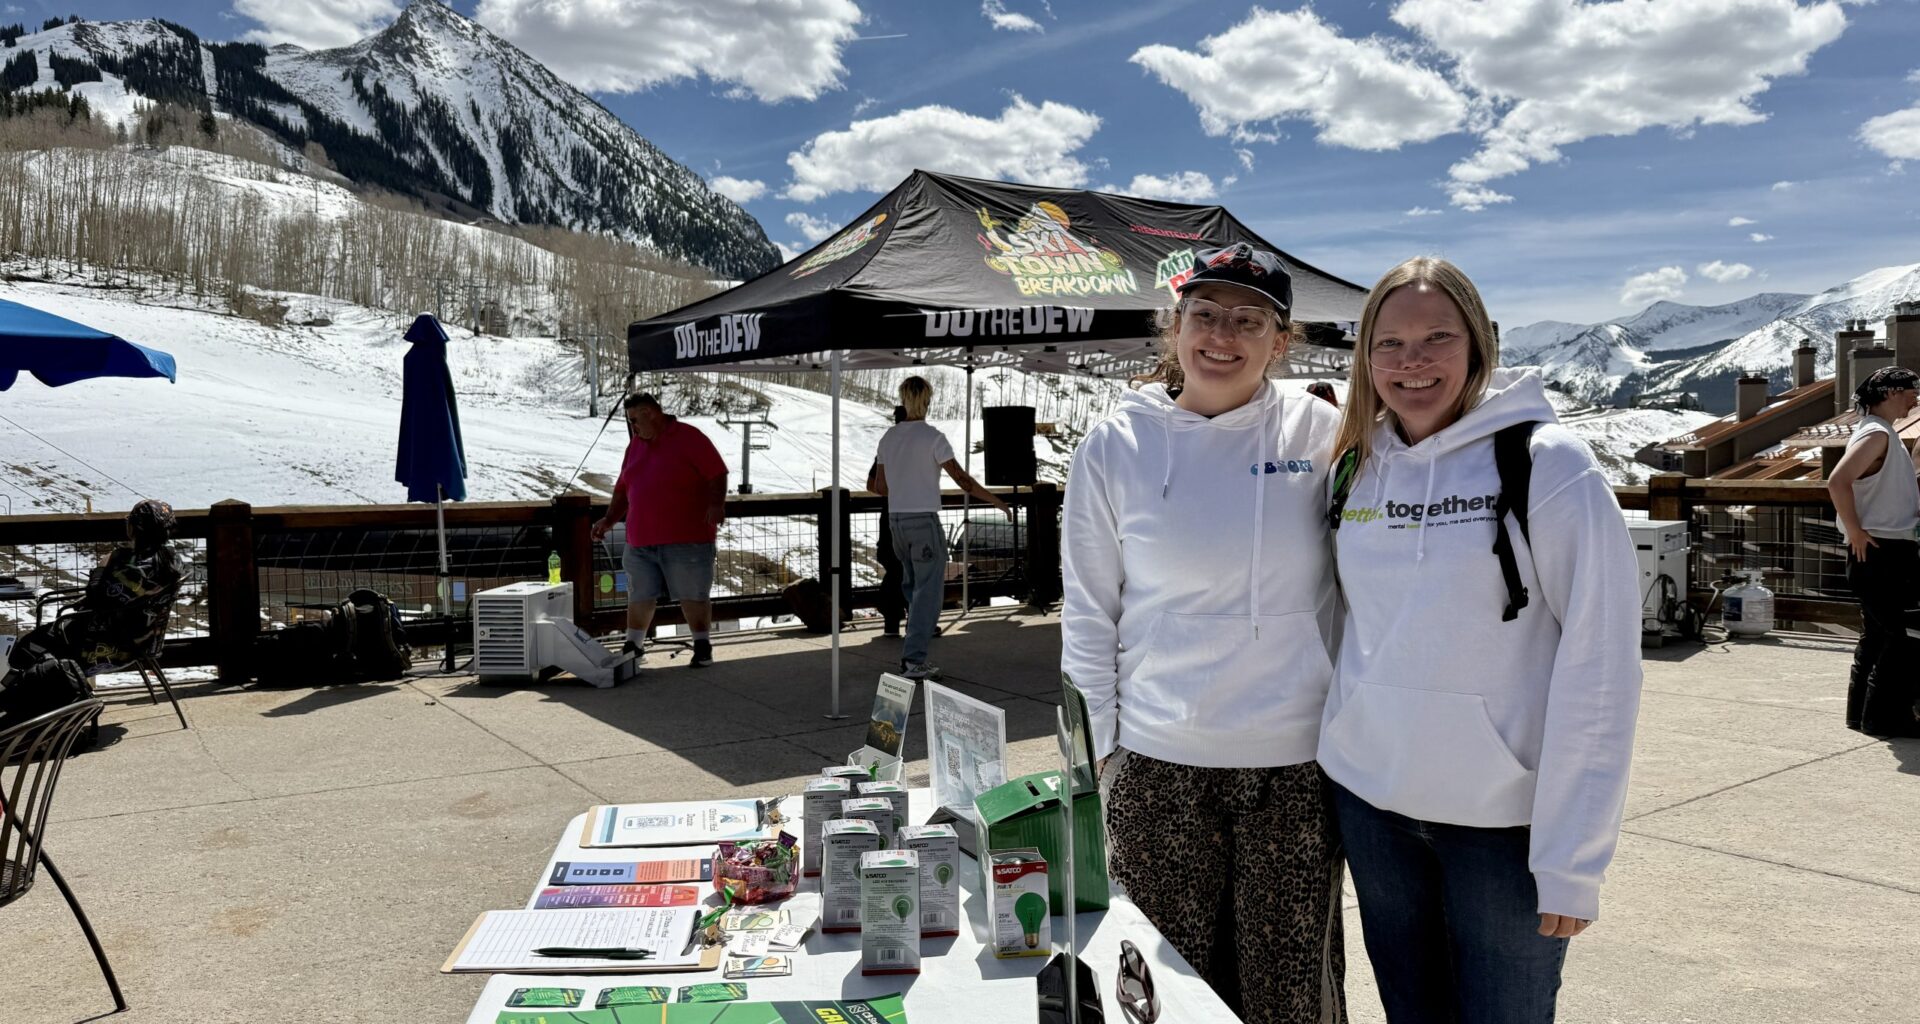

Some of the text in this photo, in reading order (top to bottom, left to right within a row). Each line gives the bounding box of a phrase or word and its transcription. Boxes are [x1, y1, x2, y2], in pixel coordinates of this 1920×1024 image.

[1008, 230, 1069, 254] SKI
[997, 252, 1106, 276] TOWN
[1159, 249, 1195, 282] Mtn
[1014, 268, 1138, 296] BREAKDOWN
[925, 305, 1095, 337] DO THE DEW
[673, 313, 764, 360] DO THE DEW
[1000, 867, 1021, 875] SATCO
